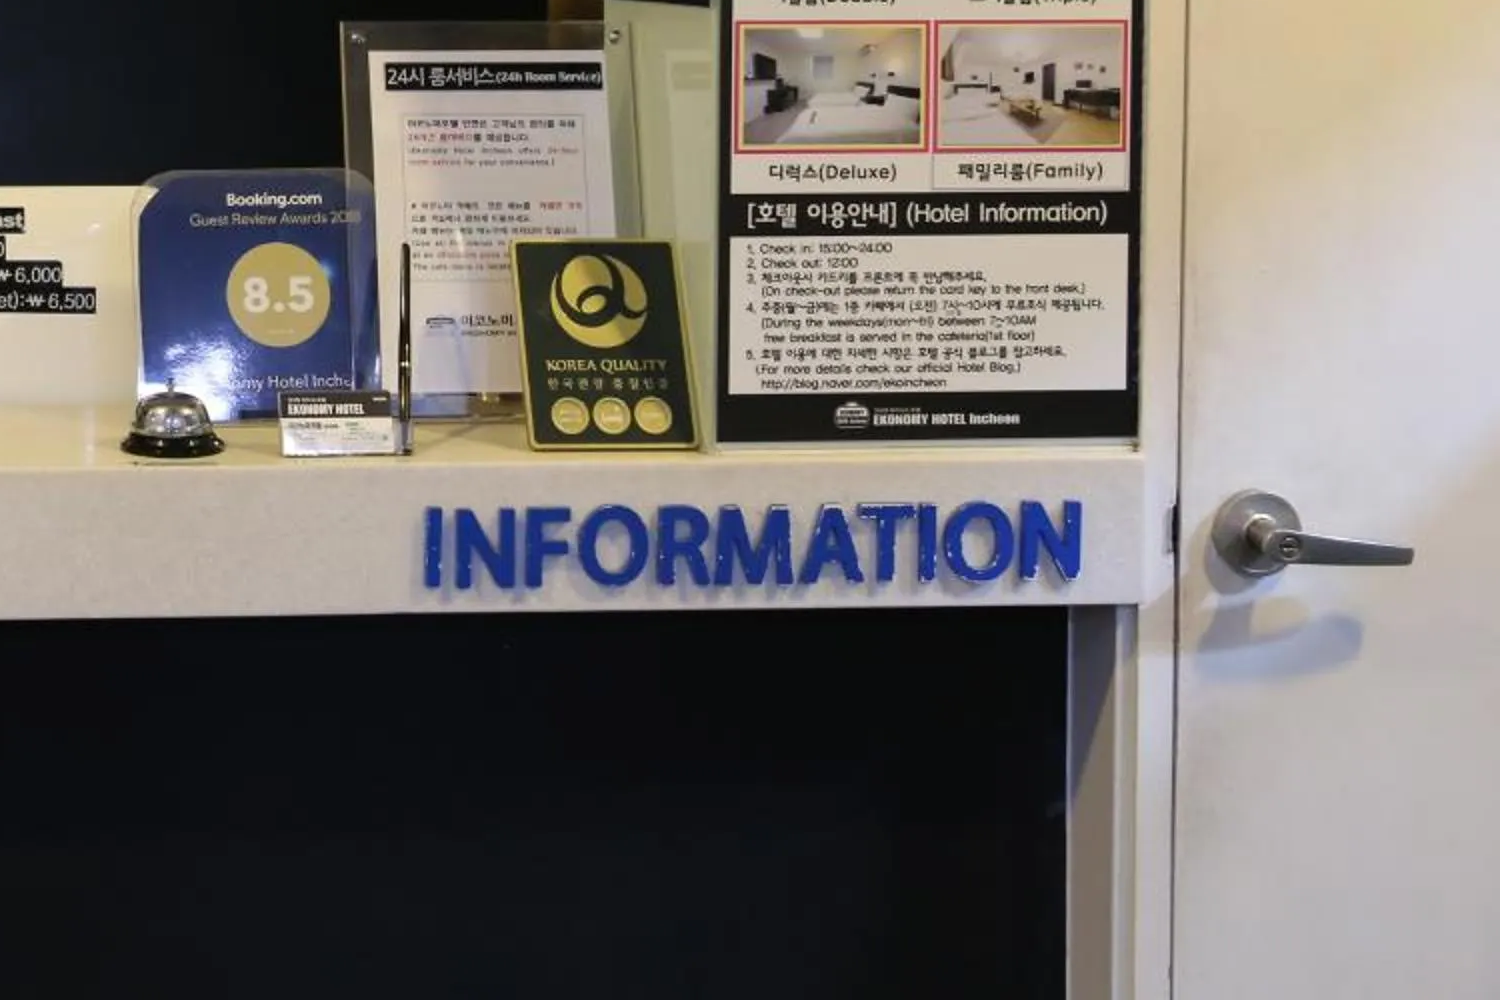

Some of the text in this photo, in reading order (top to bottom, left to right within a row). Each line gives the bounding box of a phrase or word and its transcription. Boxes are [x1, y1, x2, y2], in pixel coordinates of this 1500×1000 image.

[387, 67, 425, 85] 24시
[525, 71, 556, 83] Room
[769, 164, 897, 183] 디럭스(Deluxe)
[958, 162, 1104, 181] 패밀리룸(Family)
[226, 192, 323, 208] Booking.com
[189, 212, 328, 228] Guest Review Awards
[747, 201, 1108, 229] [호텔 이용안내] (Hotel Information)
[759, 243, 796, 255] Check
[761, 257, 797, 269] Check
[827, 256, 859, 269] 12:00
[15, 267, 63, 286] 6,000
[243, 276, 315, 314] 8.5
[785, 285, 841, 297] check-out
[844, 286, 881, 298] please
[919, 285, 936, 295] the
[968, 285, 986, 296] key
[991, 285, 1001, 295] to
[1005, 284, 1022, 294] the
[48, 293, 96, 311] 6,500
[805, 317, 823, 328] the
[938, 315, 985, 327] between
[789, 332, 842, 343] breakfast
[859, 332, 897, 343] served
[915, 331, 934, 342] the
[545, 359, 668, 374] KOREA QUALITY
[783, 365, 811, 375] more
[855, 363, 889, 375] check
[894, 364, 912, 375] our
[957, 362, 986, 373] Hotel
[268, 374, 309, 390] Hotel
[335, 403, 365, 415] HOTEL
[873, 413, 929, 426] EKONOMY
[931, 413, 967, 425] HOTEL
[423, 500, 1083, 591] INFORMATION
